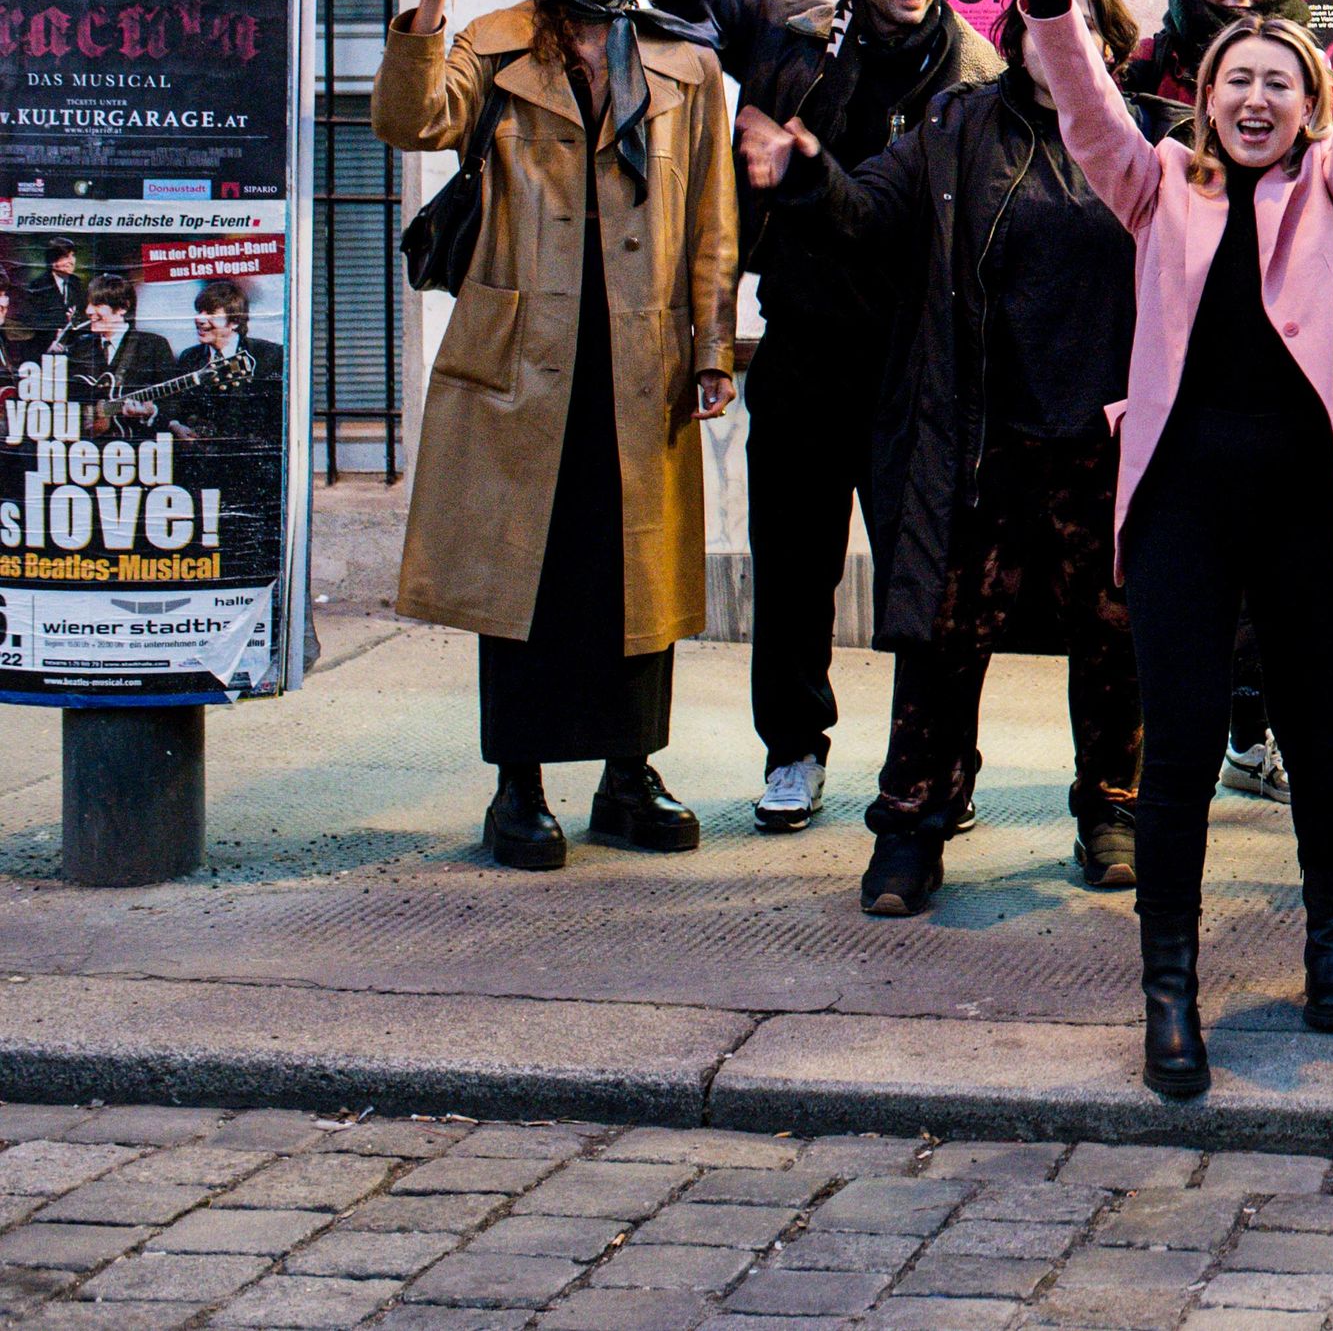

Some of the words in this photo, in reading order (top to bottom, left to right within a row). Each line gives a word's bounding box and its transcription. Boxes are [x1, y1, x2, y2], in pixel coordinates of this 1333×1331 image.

[28, 73, 63, 86] DAS
[72, 74, 171, 88] MUSICAL
[66, 98, 97, 106] TICKETS
[100, 99, 128, 107] UNTER
[148, 183, 207, 194] Donaustadt
[243, 186, 278, 194] SIPARIO
[17, 212, 84, 228] präsentiert
[88, 214, 112, 227] das
[117, 213, 174, 227] nächste
[179, 215, 251, 229] Top-Event
[150, 250, 168, 261] Mit
[168, 248, 187, 260] der
[188, 241, 277, 260] Original-Band
[170, 266, 190, 278] aus
[191, 262, 214, 276] Las
[215, 258, 260, 275] Vegas!
[18, 354, 68, 402] all
[5, 400, 81, 445] you
[37, 432, 173, 486] need
[25, 471, 221, 550] love!
[25, 553, 221, 581] Beatles-Musical
[43, 620, 124, 635] wiener
[129, 640, 141, 648] ein
[144, 639, 197, 648] unternehmen
[44, 677, 143, 687] www.beatles-musical.com
